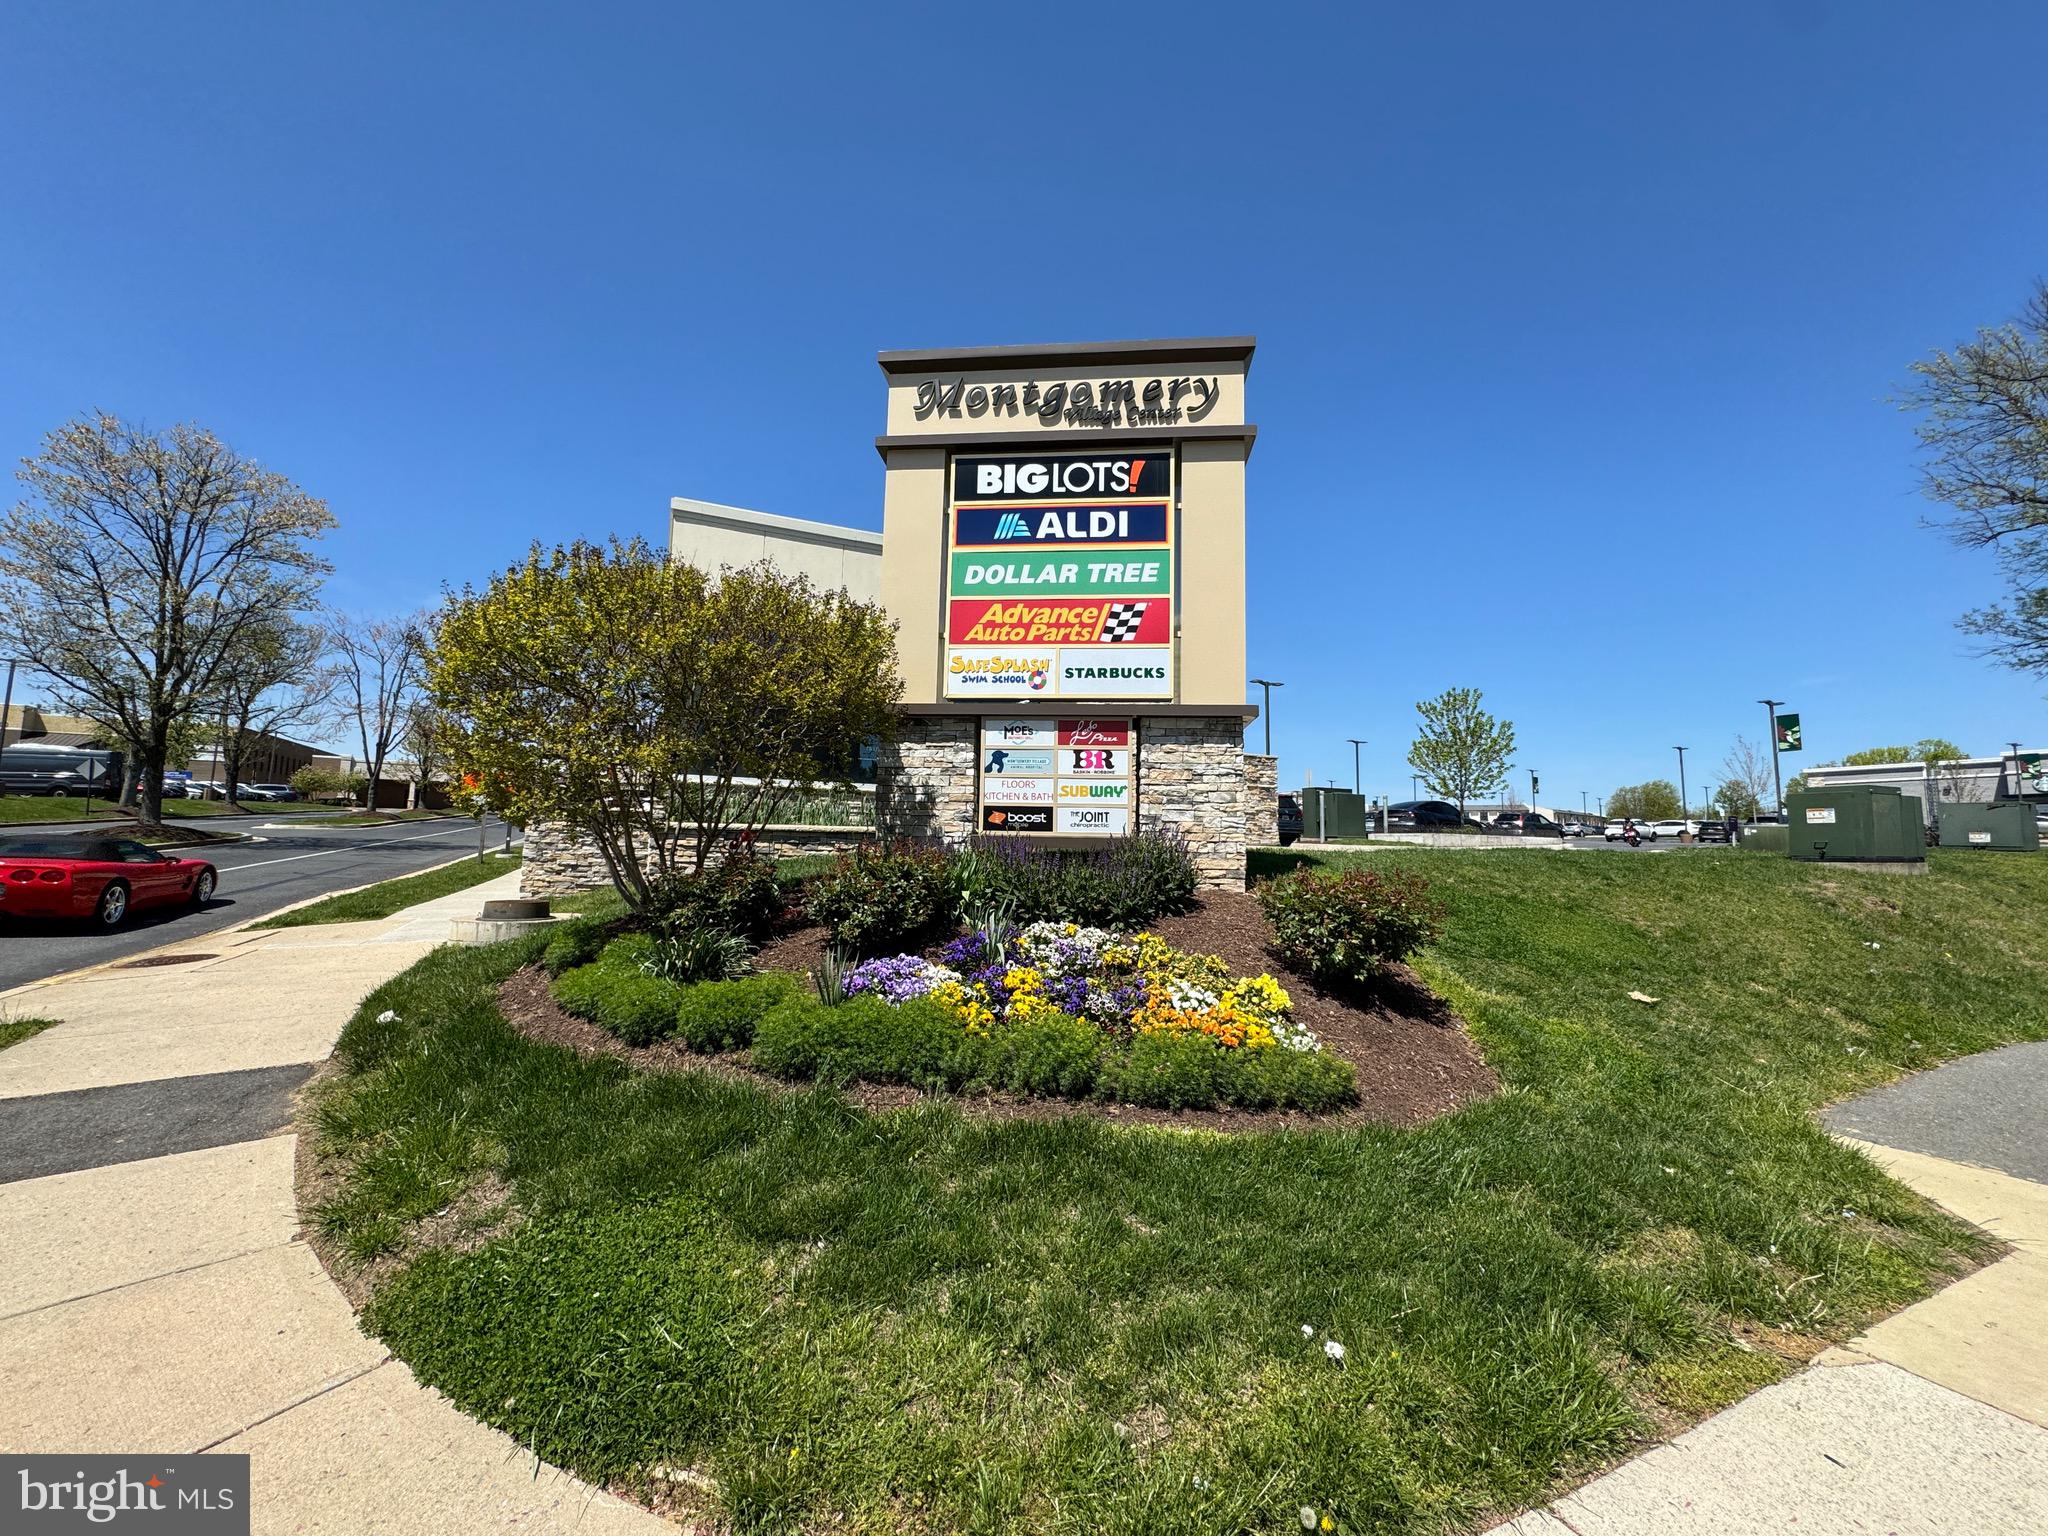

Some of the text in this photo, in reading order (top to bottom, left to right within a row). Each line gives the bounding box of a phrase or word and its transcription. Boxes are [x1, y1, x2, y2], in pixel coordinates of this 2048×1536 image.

[913, 375, 1218, 417] Montgomery
[1065, 404, 1182, 426] Village Center
[1036, 510, 1128, 539] ALDI
[964, 562, 1160, 585] DOLLAR TREE
[978, 603, 1098, 625] Advance
[963, 623, 1092, 642] Auto Parts
[961, 674, 1027, 684] SWIM SCHOOL
[1064, 667, 1165, 679] STARBUCKS
[1001, 780, 1036, 788] FLOORS
[984, 792, 1020, 800] KITCHEN
[1022, 792, 1029, 800] &
[1059, 785, 1128, 798] SUBWAY
[1007, 812, 1047, 823] boost
[1079, 811, 1110, 823] JOINT
